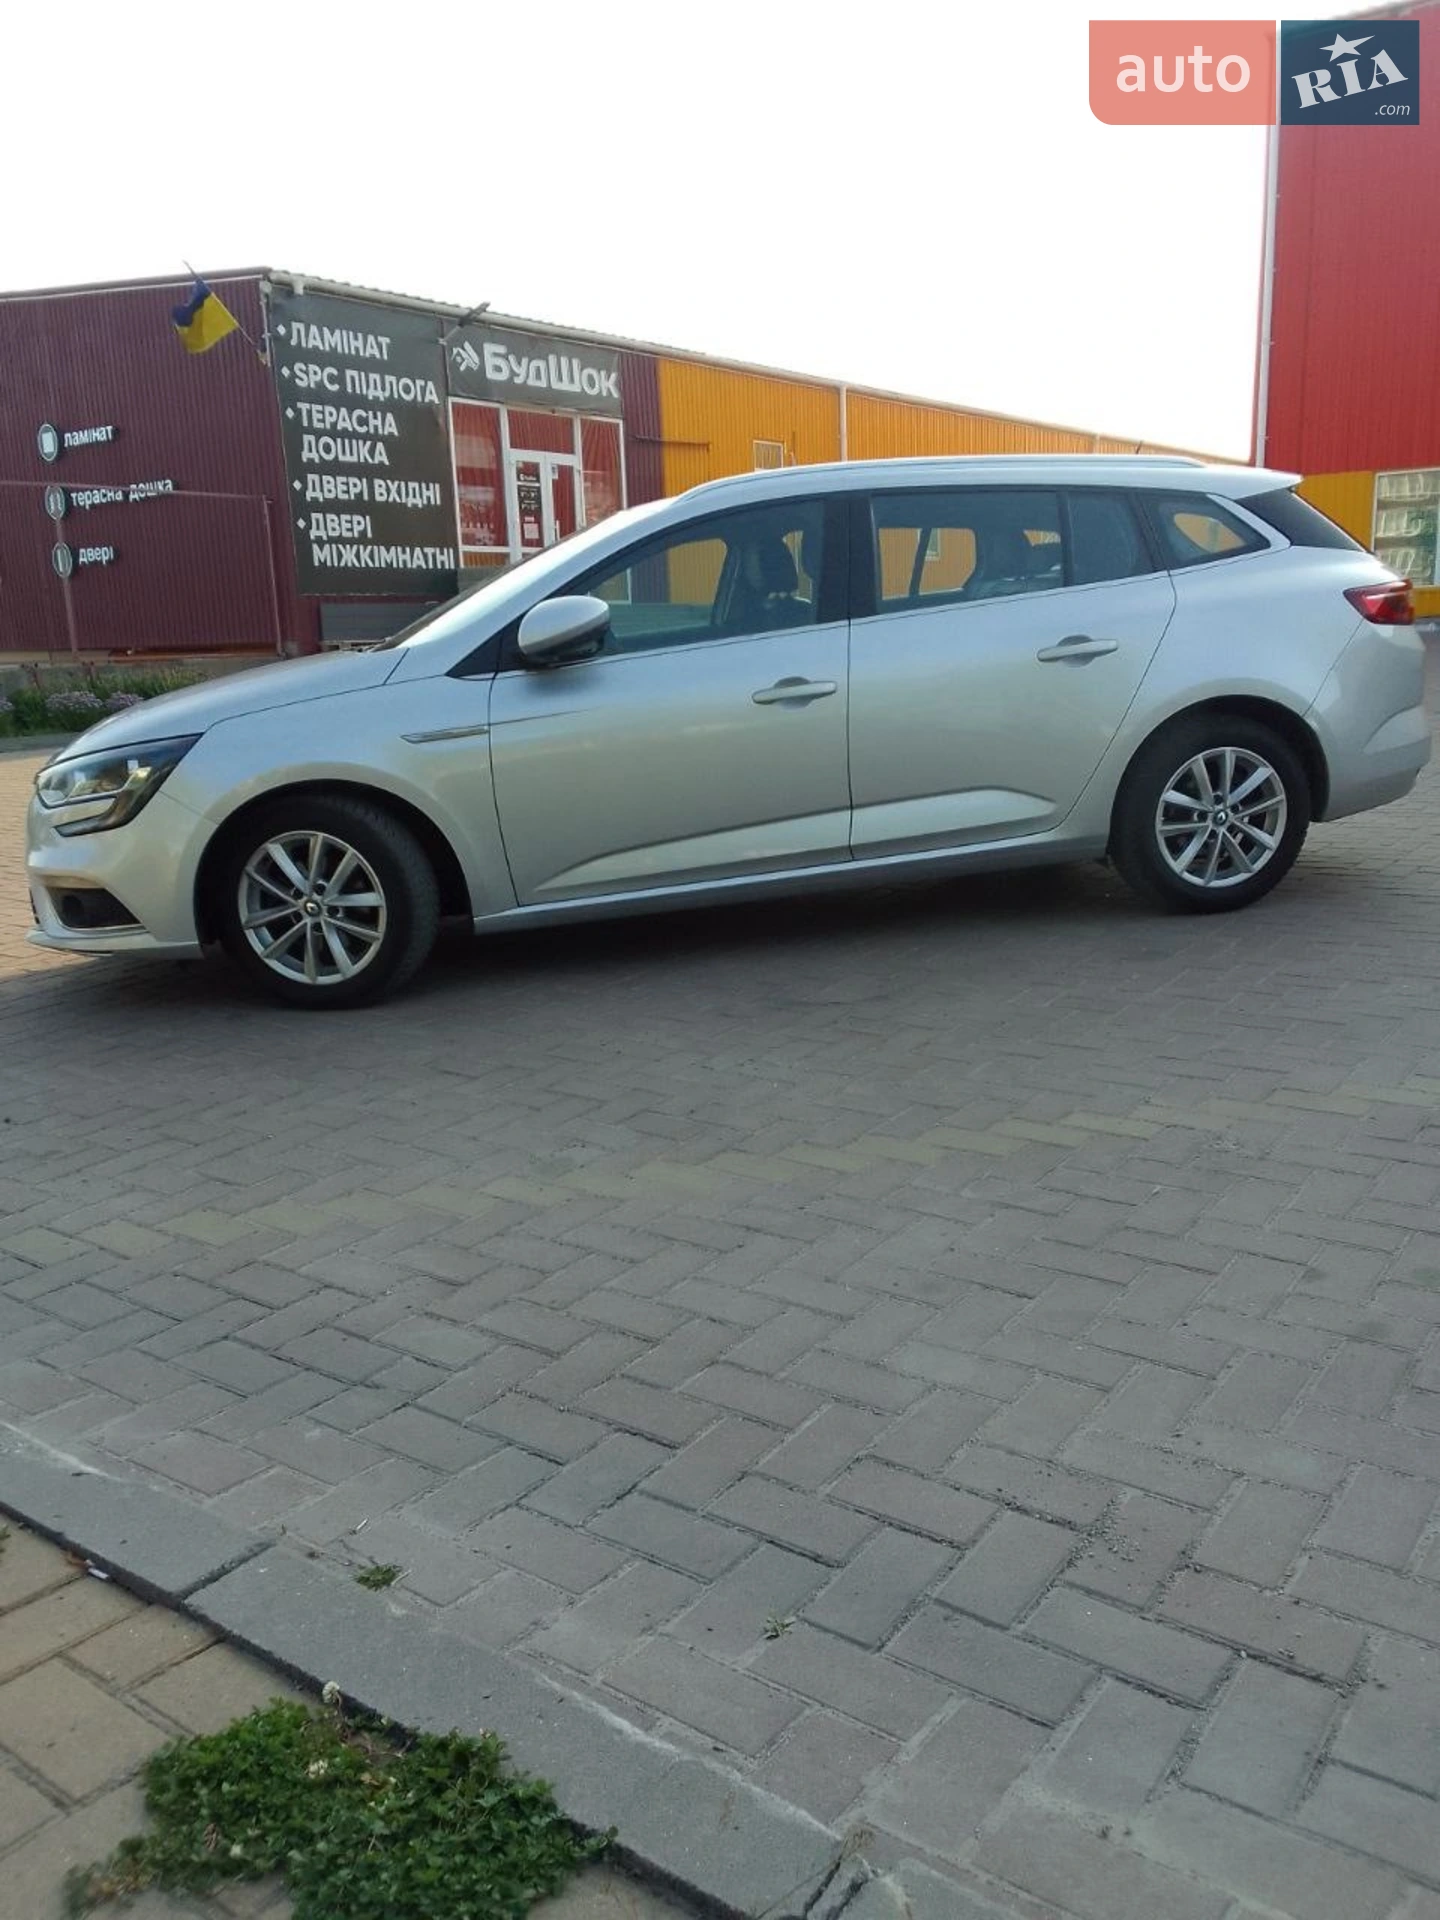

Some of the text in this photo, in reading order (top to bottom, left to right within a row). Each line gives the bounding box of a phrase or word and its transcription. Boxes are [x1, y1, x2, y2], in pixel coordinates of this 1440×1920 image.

[290, 322, 390, 360] ЛАМІНАТ
[293, 365, 440, 404] SPC ПІДЛОГА
[297, 402, 398, 436] ТЕРАСНА
[64, 425, 113, 447] ламінат
[302, 435, 389, 465] ДОШКА
[71, 479, 173, 509] терасна дошка
[306, 474, 441, 507] ДВЕРІ ВХІДНІ
[310, 513, 372, 540] ДВЕРІ
[79, 546, 113, 566] двері
[312, 542, 454, 569] МІЖКІМНАТНІ
